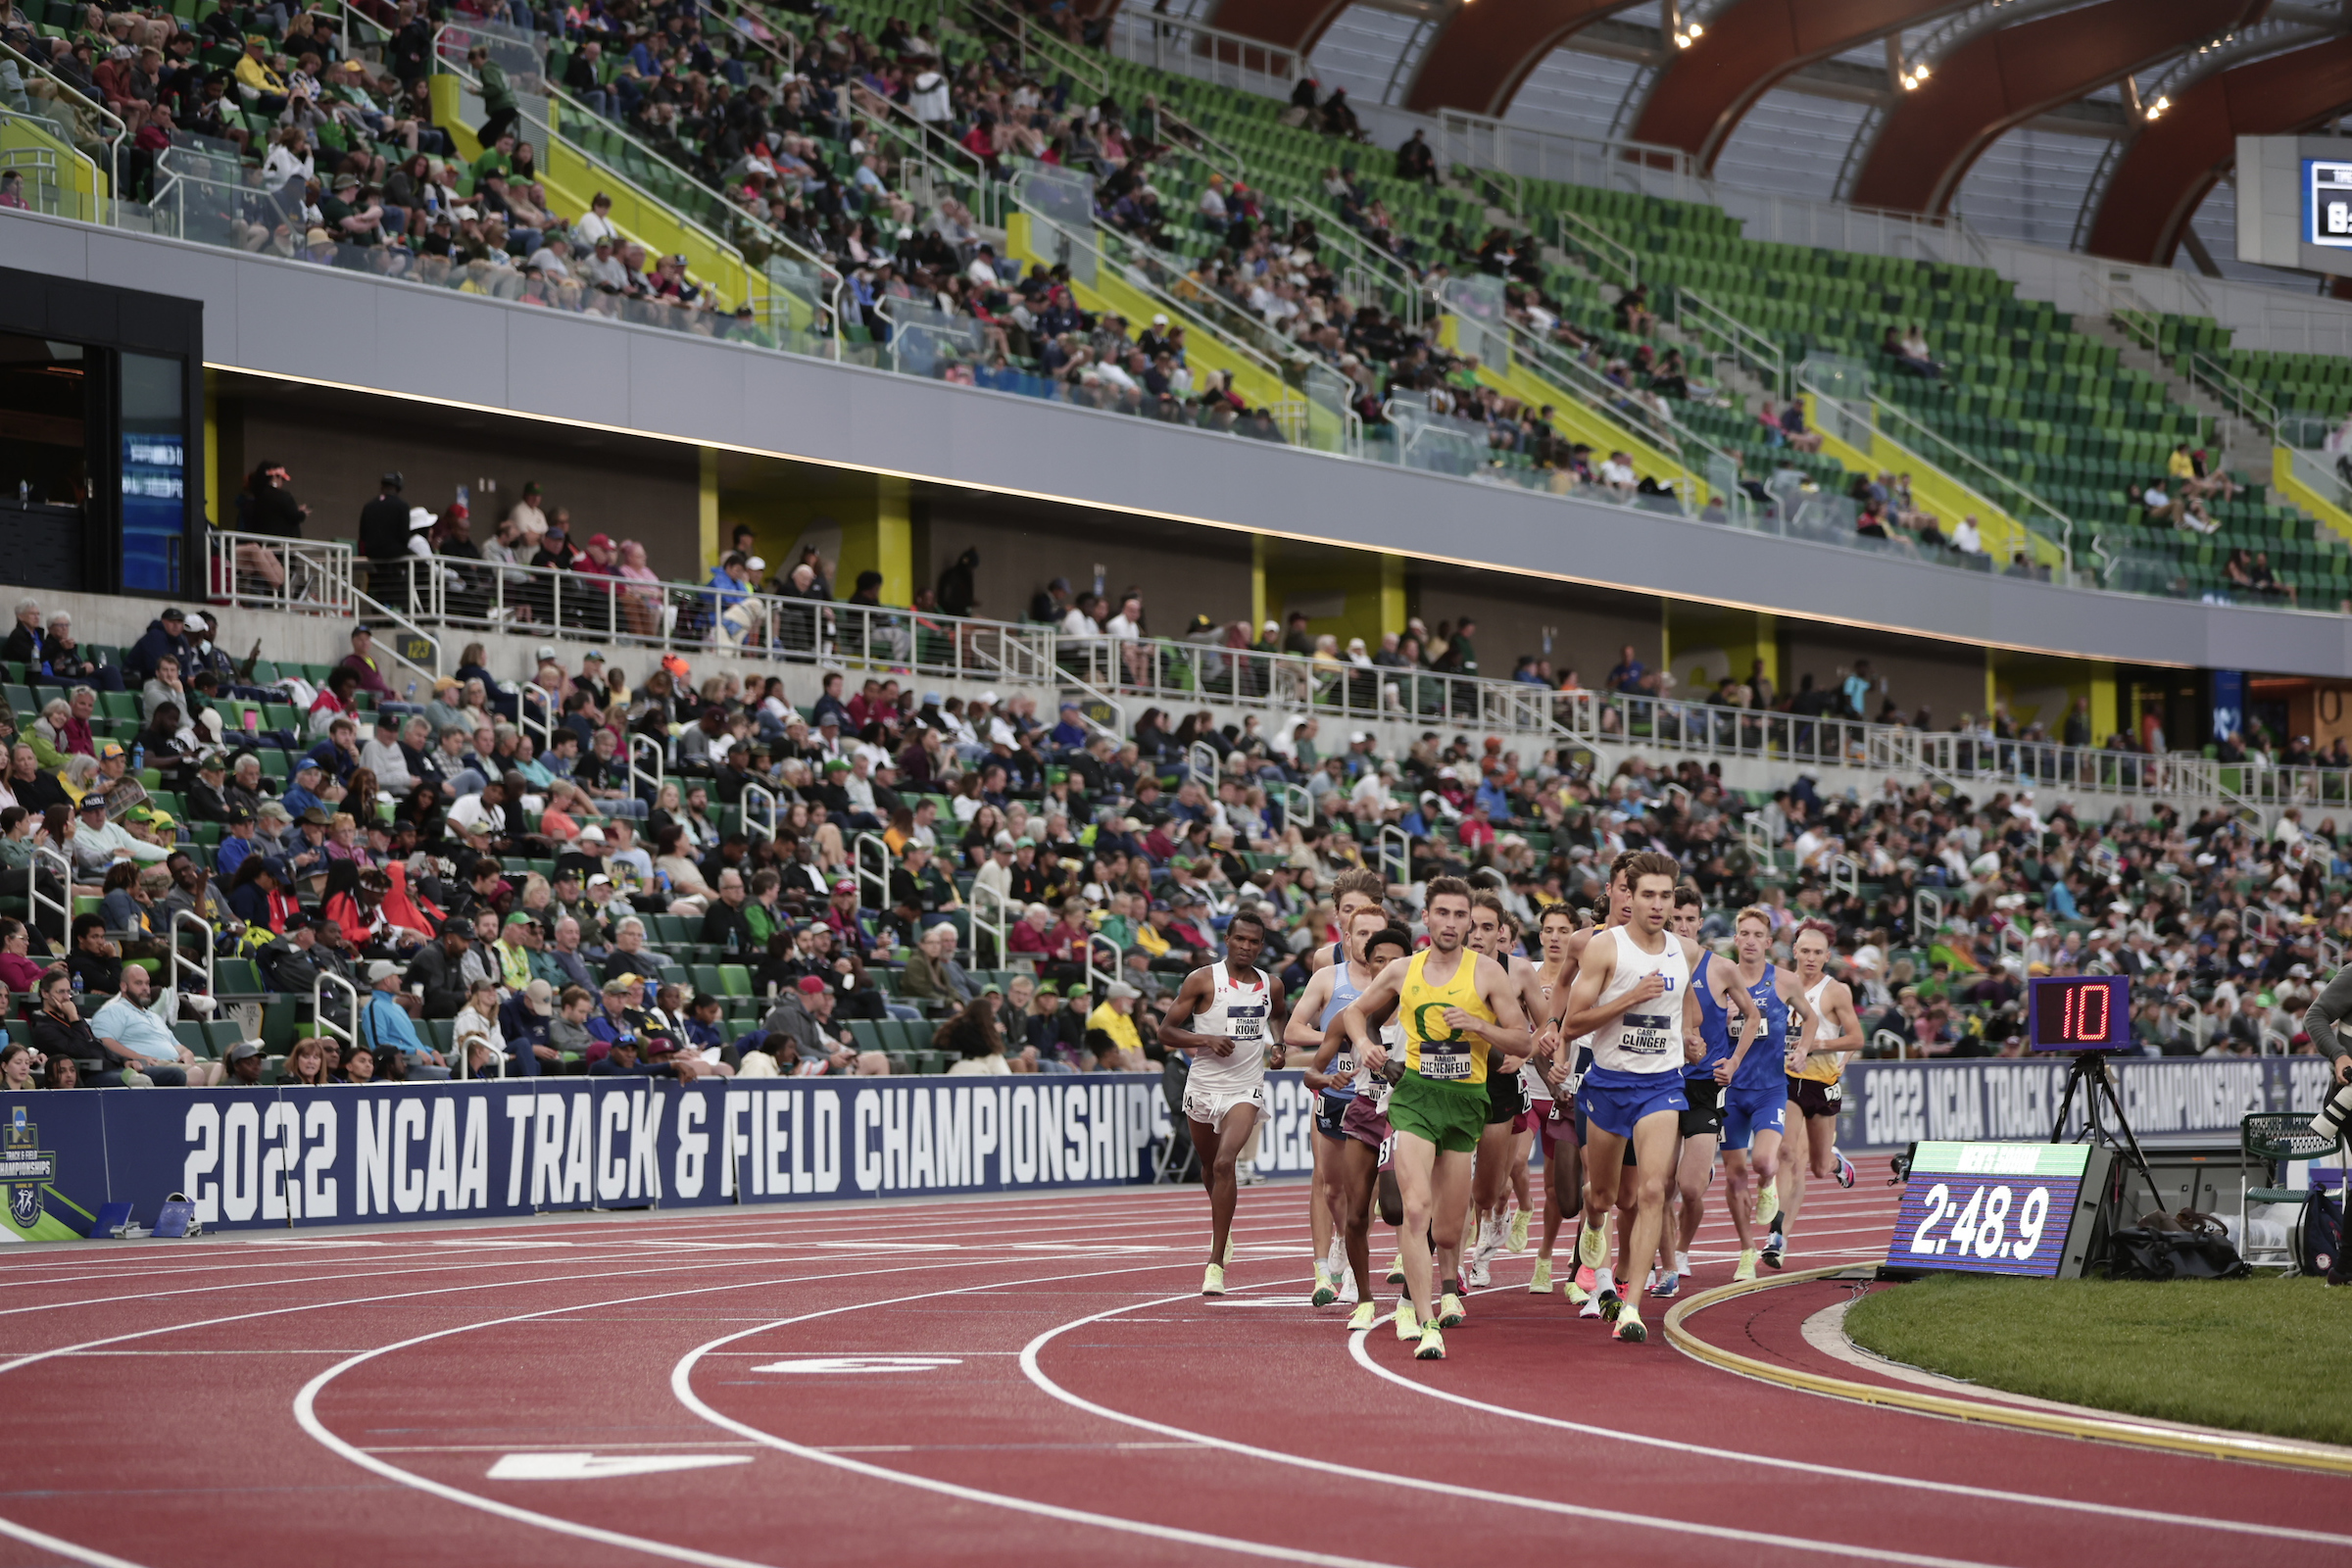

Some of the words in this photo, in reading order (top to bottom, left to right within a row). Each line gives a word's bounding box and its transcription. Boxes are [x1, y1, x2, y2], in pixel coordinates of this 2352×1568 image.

[408, 640, 430, 659] 123
[1752, 998, 1768, 1006] RCE
[2063, 984, 2110, 1041] 10
[1235, 1025, 1260, 1035] KIOKO
[1637, 1028, 1656, 1037] CASEY
[1623, 1034, 1667, 1049] CLINGER
[1420, 1061, 1470, 1074] BIENENFELD
[1865, 1067, 1925, 1144] 2022
[1928, 1066, 1983, 1139] NCAA
[1985, 1065, 2049, 1136] TRACK
[2123, 1061, 2265, 1132] CHAMPIONSHIPS
[1255, 1079, 1315, 1172] 022
[184, 1101, 337, 1222] 2022
[356, 1095, 488, 1215] NCAA
[507, 1089, 662, 1206] TRACK
[676, 1091, 710, 1199] &
[721, 1087, 841, 1198] FIELD
[855, 1082, 1173, 1193] CHAMPIONSHIPS
[0, 1160, 51, 1176] HAMPIONSHIPS
[1910, 1183, 2049, 1260] 2:48.9
